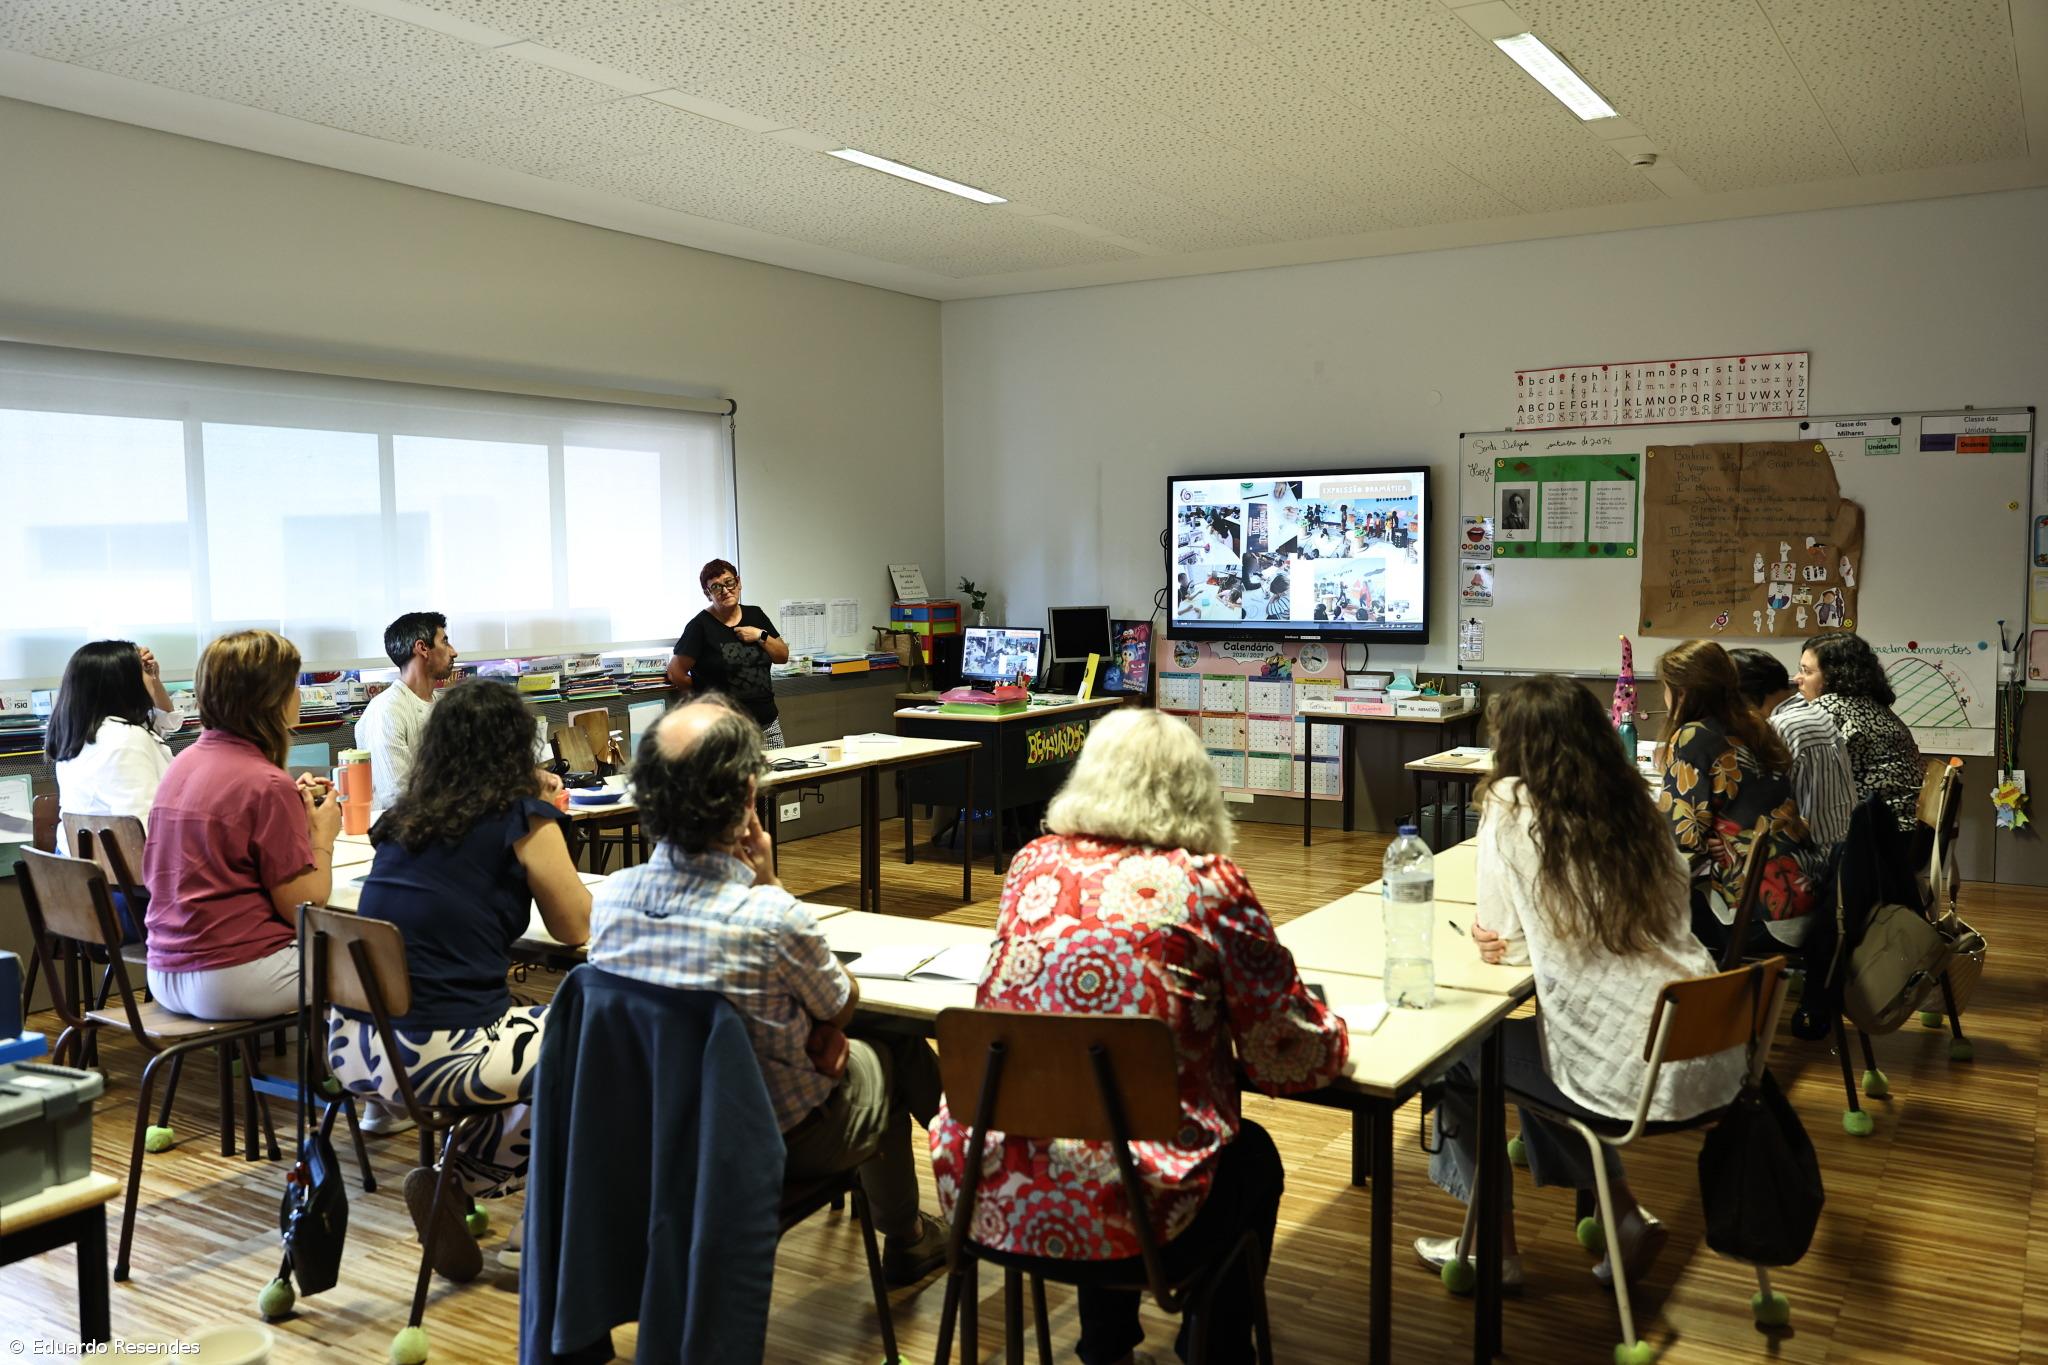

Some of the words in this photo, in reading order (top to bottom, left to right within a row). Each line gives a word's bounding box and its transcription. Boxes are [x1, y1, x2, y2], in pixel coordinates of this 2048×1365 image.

[1517, 405, 1524, 413] A
[1528, 404, 1534, 412] B
[1538, 403, 1544, 411] C
[1548, 402, 1555, 411] D
[1559, 401, 1565, 410] E
[1570, 400, 1576, 409] F
[1580, 400, 1587, 409] G
[1591, 400, 1598, 408] H
[1614, 398, 1619, 407] J
[1625, 398, 1631, 407] K
[1636, 397, 1642, 406] L
[1645, 397, 1655, 405] M
[1658, 396, 1665, 405] N
[1668, 395, 1676, 404] O
[1680, 395, 1687, 404] P
[1691, 394, 1699, 404] Q
[1703, 393, 1710, 402] R
[1715, 393, 1722, 402] S
[1726, 392, 1732, 401] T
[1738, 392, 1746, 401] U
[1750, 391, 1757, 400] V
[1760, 390, 1770, 399] W
[1774, 390, 1780, 399] X
[1786, 389, 1793, 398] Y
[1798, 388, 1805, 398] Z
[1223, 642, 1274, 652] Calendário
